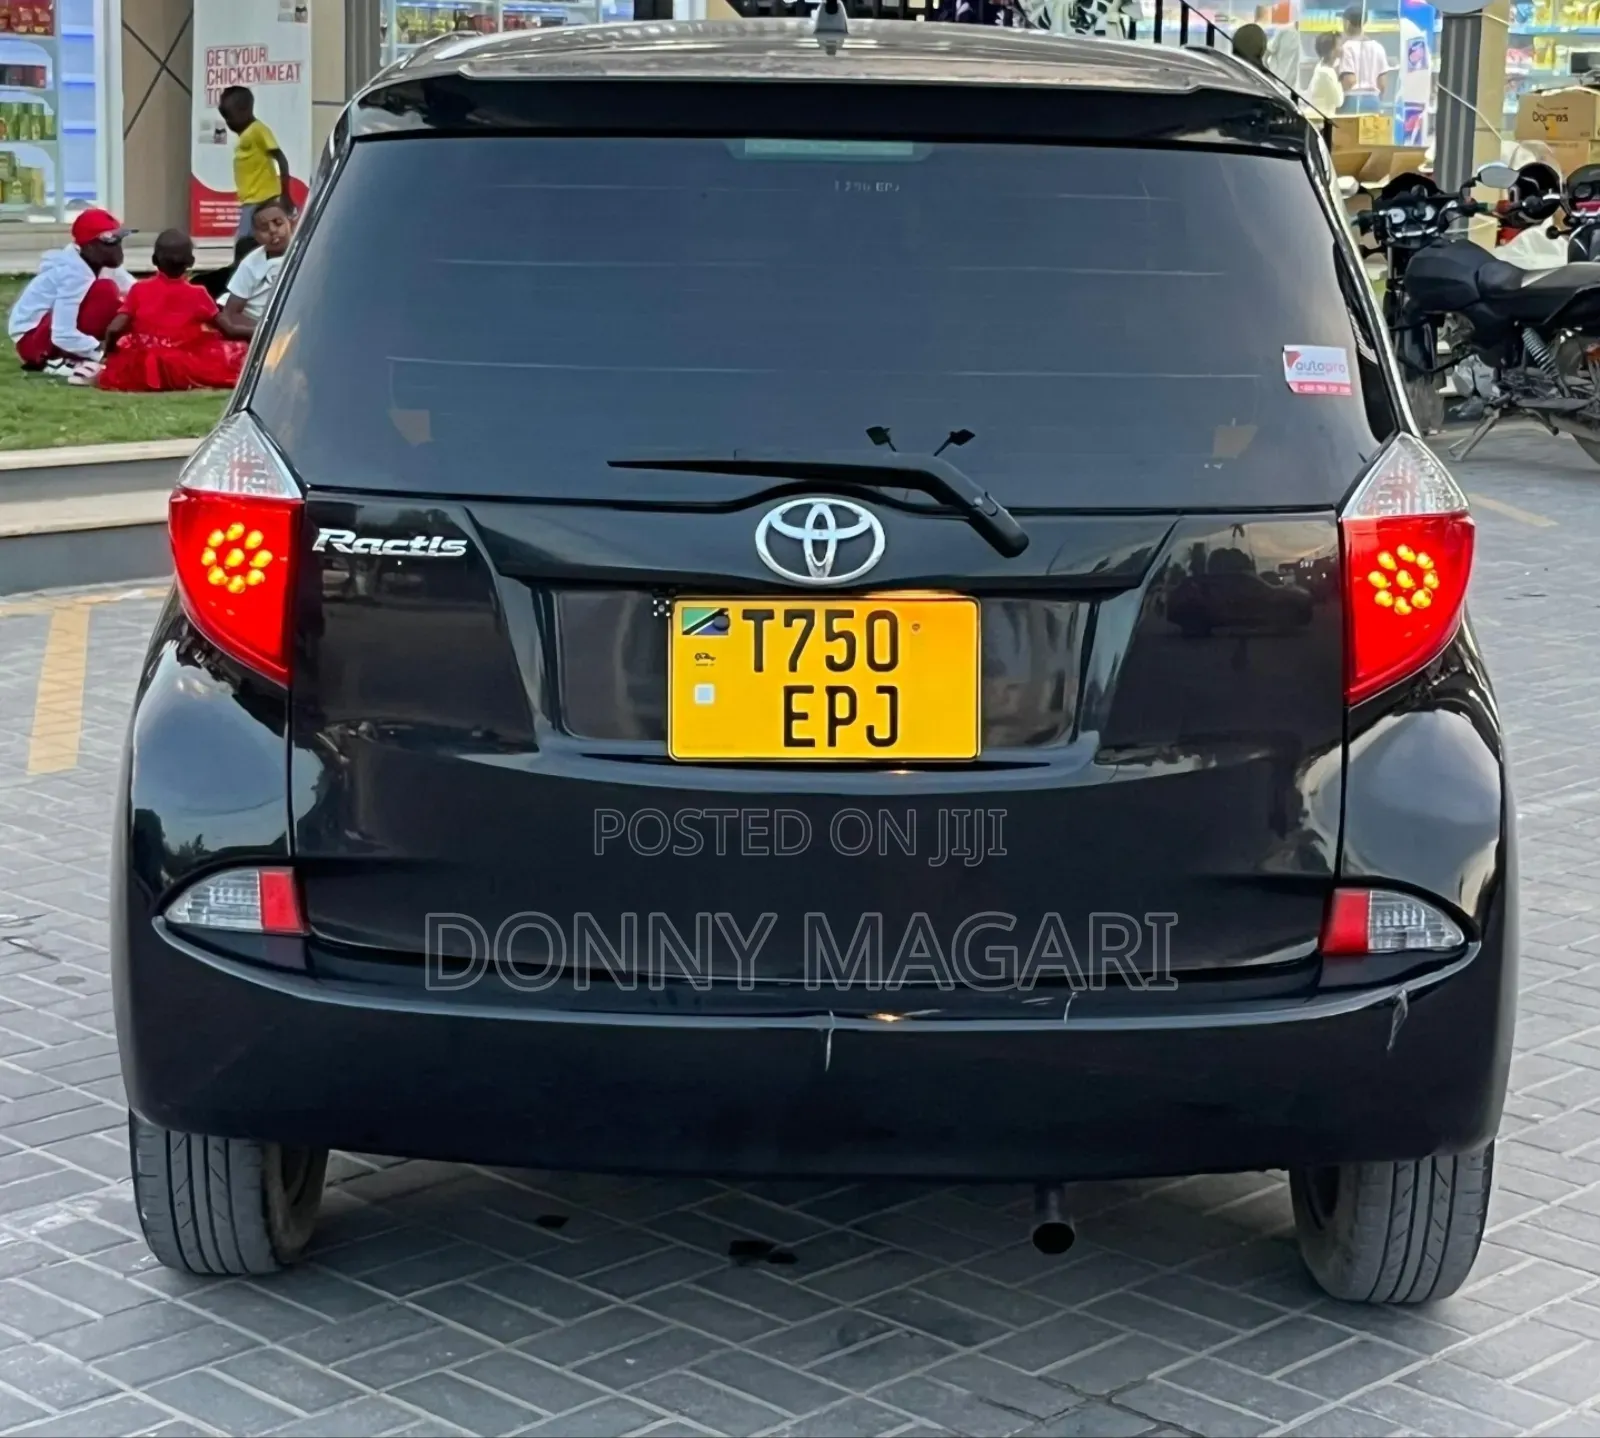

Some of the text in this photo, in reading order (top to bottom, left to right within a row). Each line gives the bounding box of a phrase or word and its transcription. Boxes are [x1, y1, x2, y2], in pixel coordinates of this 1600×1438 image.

[207, 47, 266, 67] GET YOUR
[207, 63, 301, 86] CHICKEN MEAT
[1295, 360, 1346, 375] autopro
[312, 528, 468, 557] Ractis
[742, 609, 899, 673] T750
[783, 685, 898, 748] EPJ
